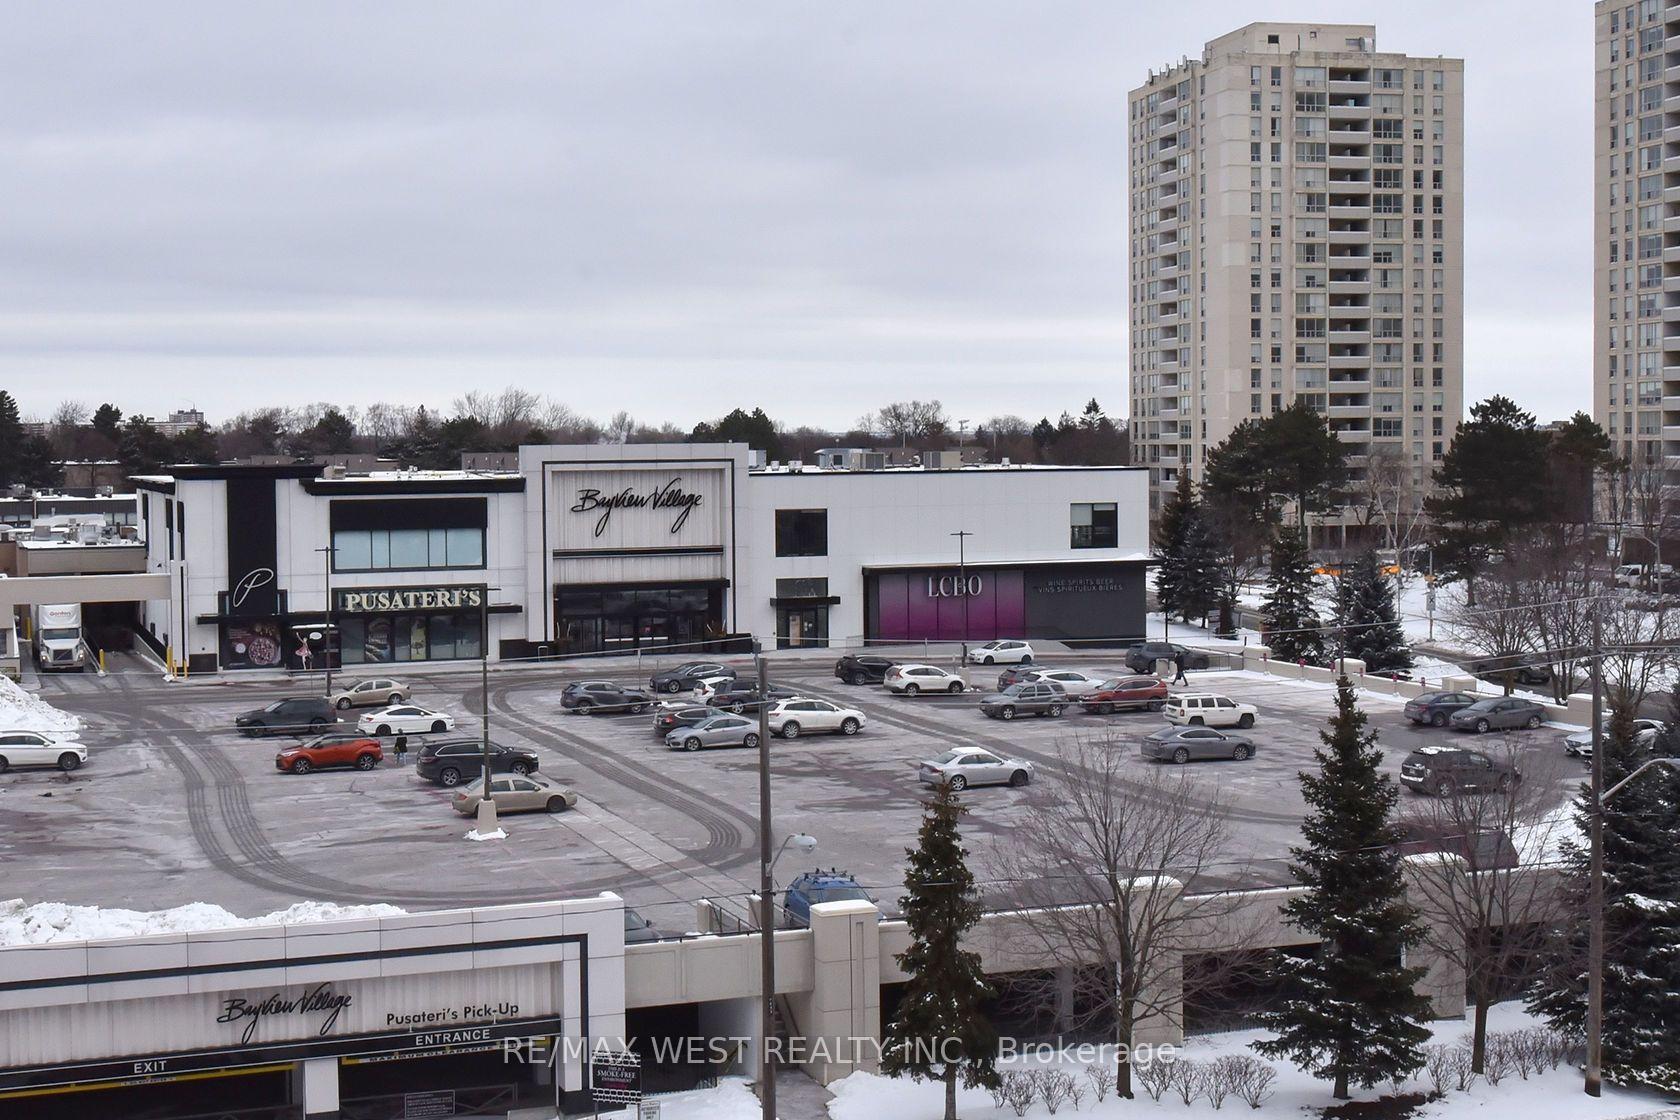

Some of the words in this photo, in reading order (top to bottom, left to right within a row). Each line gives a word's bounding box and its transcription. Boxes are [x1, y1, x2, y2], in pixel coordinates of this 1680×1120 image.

[648, 477, 702, 534] Village
[233, 568, 274, 607] P
[928, 575, 983, 597] LCBO
[345, 589, 482, 612] PUSATERI'S
[297, 982, 352, 1035] Village
[386, 1007, 458, 1026] Pusateri's
[463, 1002, 519, 1018] Pick-Up
[415, 1029, 491, 1046] ENTRANCE
[134, 1060, 167, 1074] EXIT
[597, 1070, 636, 1078] SMOKE-FREE
